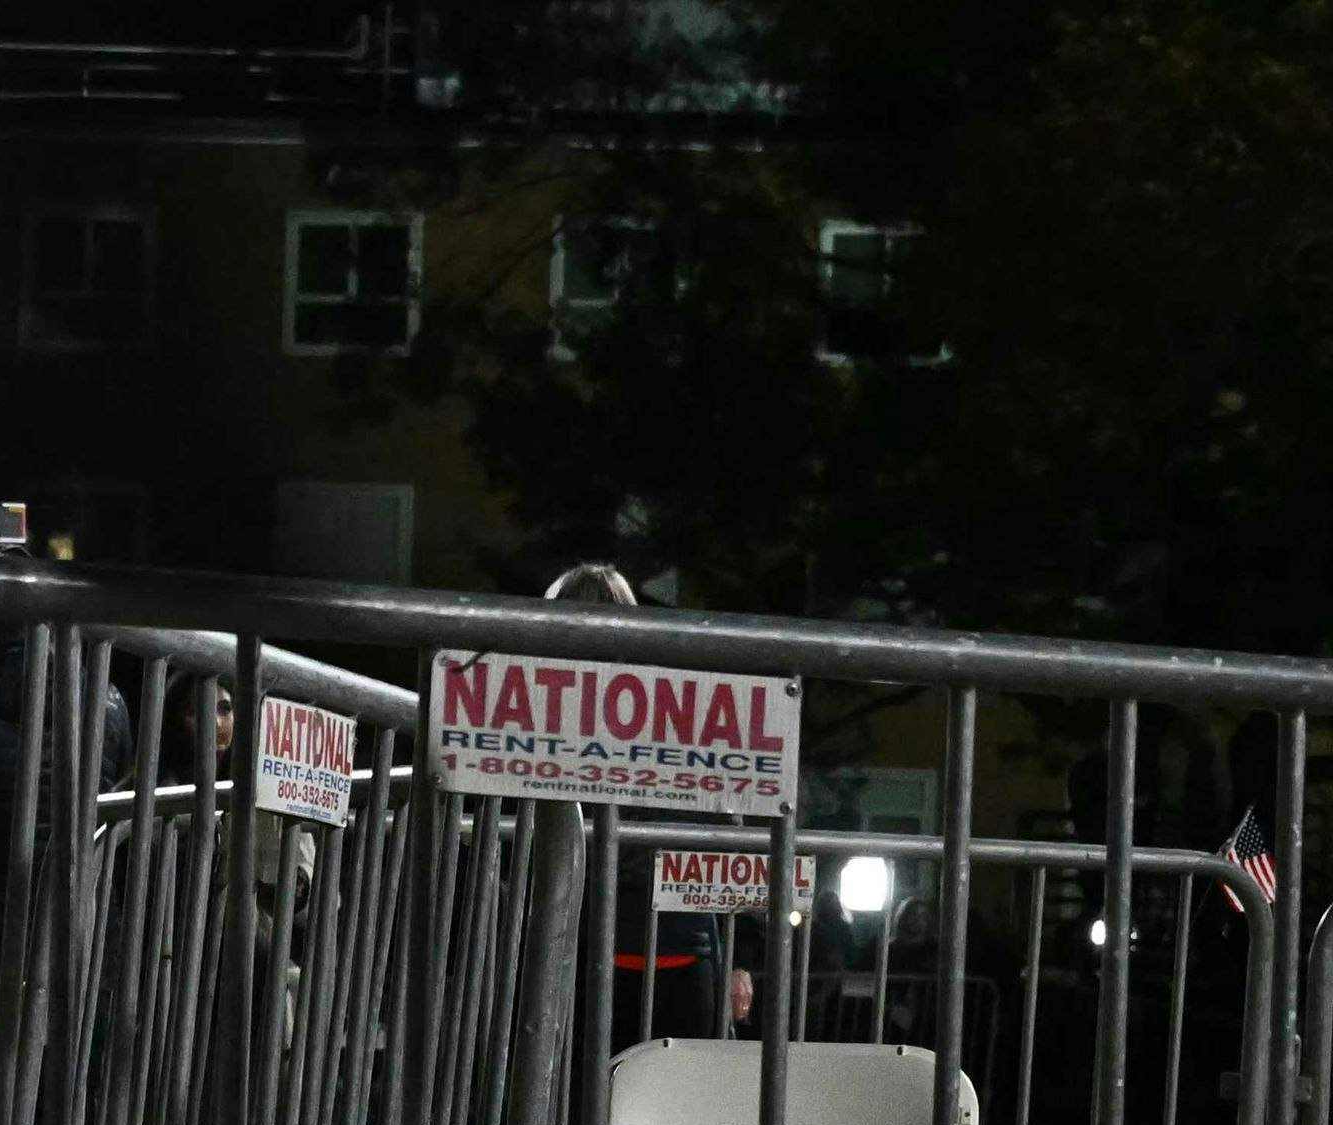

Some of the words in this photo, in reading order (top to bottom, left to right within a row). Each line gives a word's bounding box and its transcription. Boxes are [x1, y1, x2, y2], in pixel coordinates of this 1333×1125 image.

[442, 660, 783, 751] NATIONAL
[264, 701, 351, 776] NATIONAL
[441, 730, 782, 774] RENT-A-FENCE
[262, 759, 349, 794] RENT-A-FENCE
[440, 754, 781, 796] 1-800-352-5675
[522, 780, 698, 801] rentnational.com
[662, 853, 809, 888] NATIONL
[661, 884, 810, 898] RENT-A-FEE
